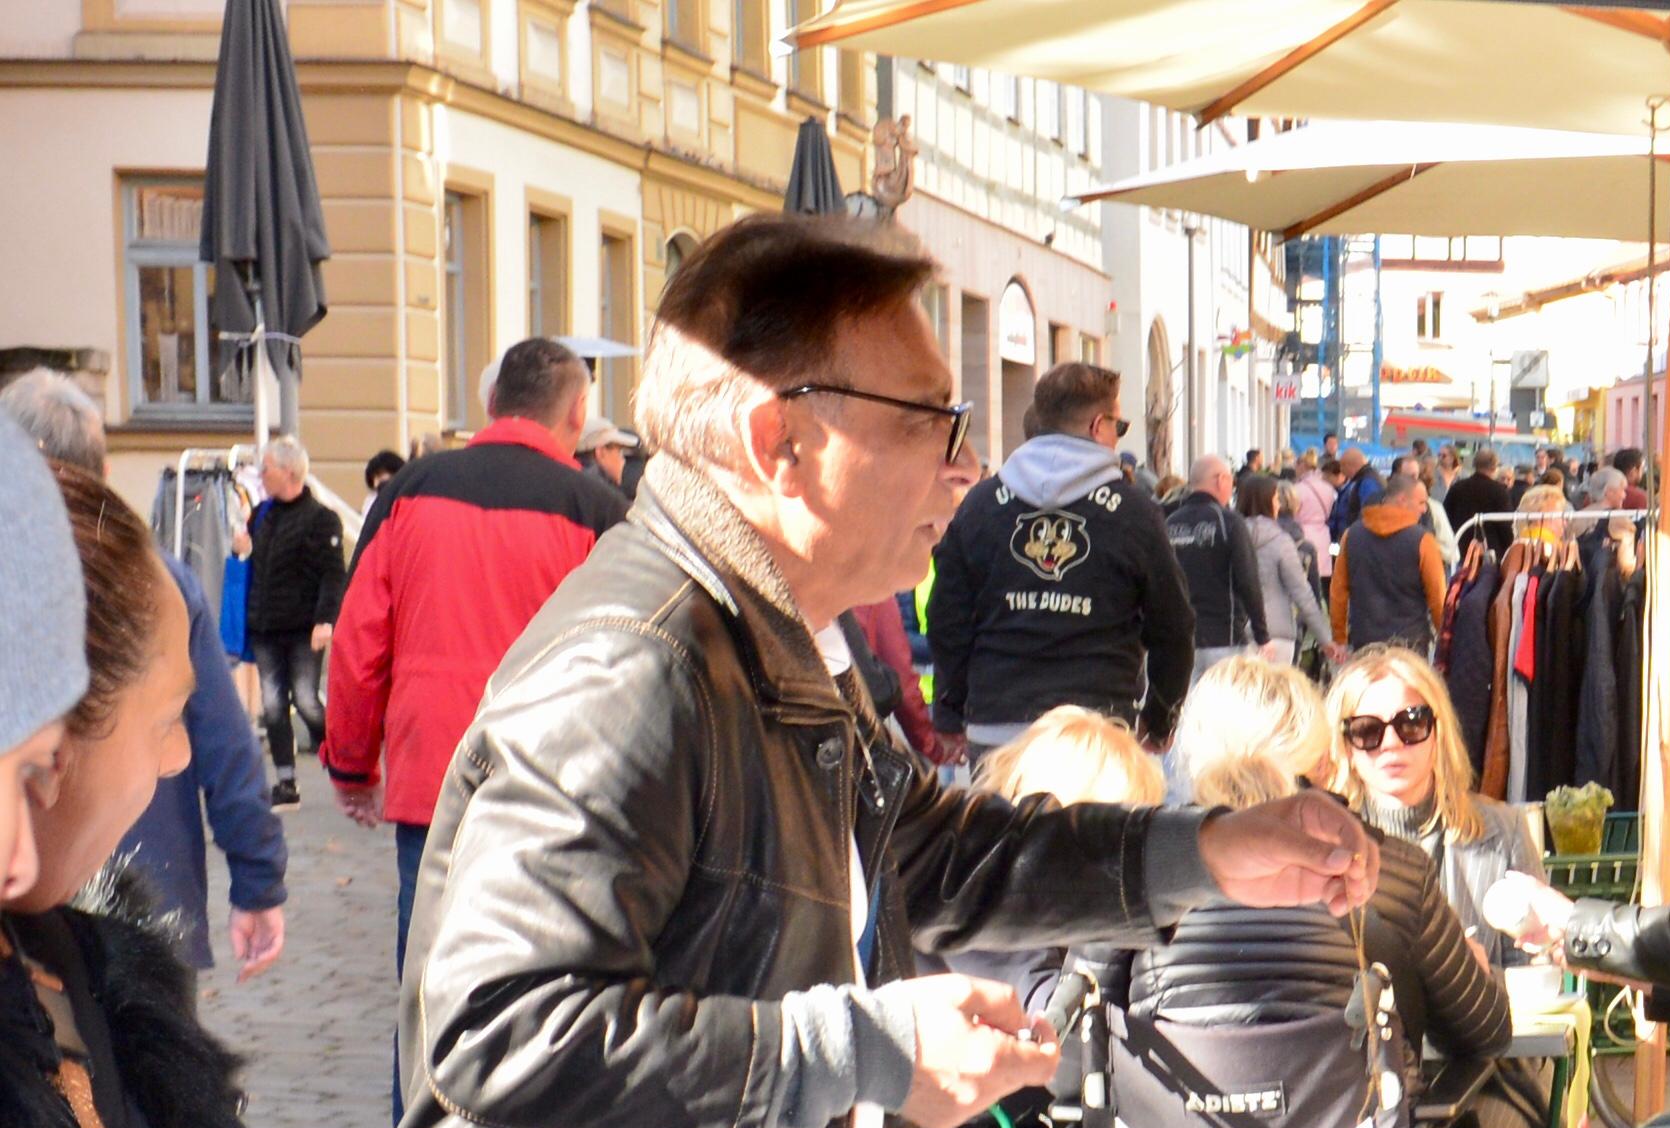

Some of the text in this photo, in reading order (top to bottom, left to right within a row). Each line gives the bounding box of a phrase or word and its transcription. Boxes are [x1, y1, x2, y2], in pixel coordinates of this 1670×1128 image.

[1275, 382, 1299, 400] kik
[1005, 591, 1093, 617] THE DUDES
[1206, 1091, 1281, 1114] DIETZ
